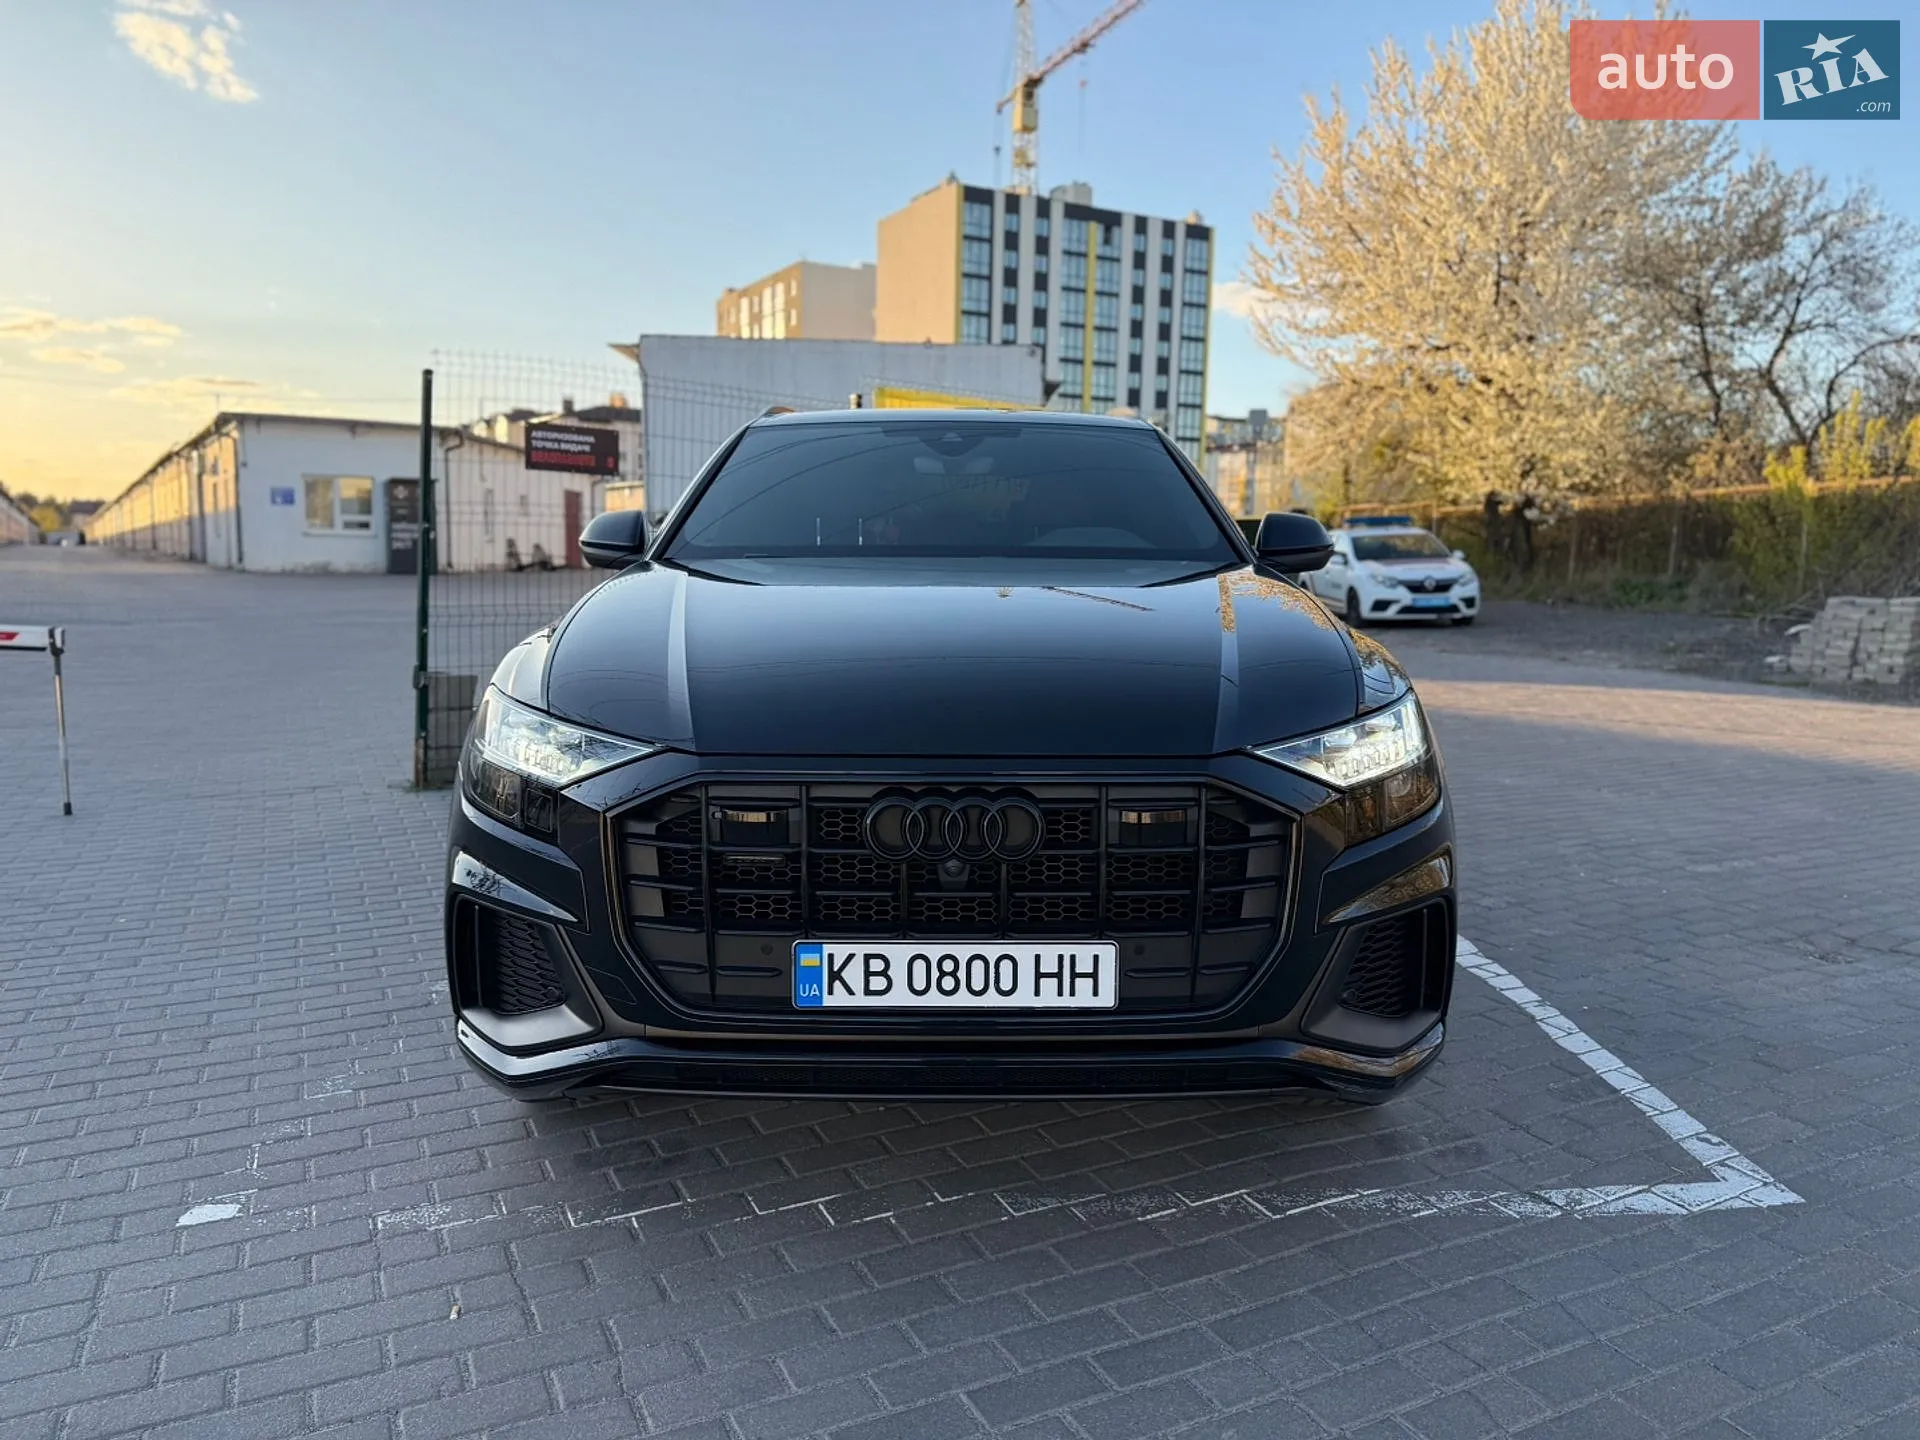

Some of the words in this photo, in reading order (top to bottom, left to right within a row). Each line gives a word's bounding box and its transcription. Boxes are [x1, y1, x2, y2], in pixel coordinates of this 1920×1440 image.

[531, 440, 559, 449] ТОЧКА
[826, 953, 893, 997] KB
[906, 953, 1019, 997] 0800
[1034, 953, 1100, 997] HH
[799, 983, 821, 997] UA
